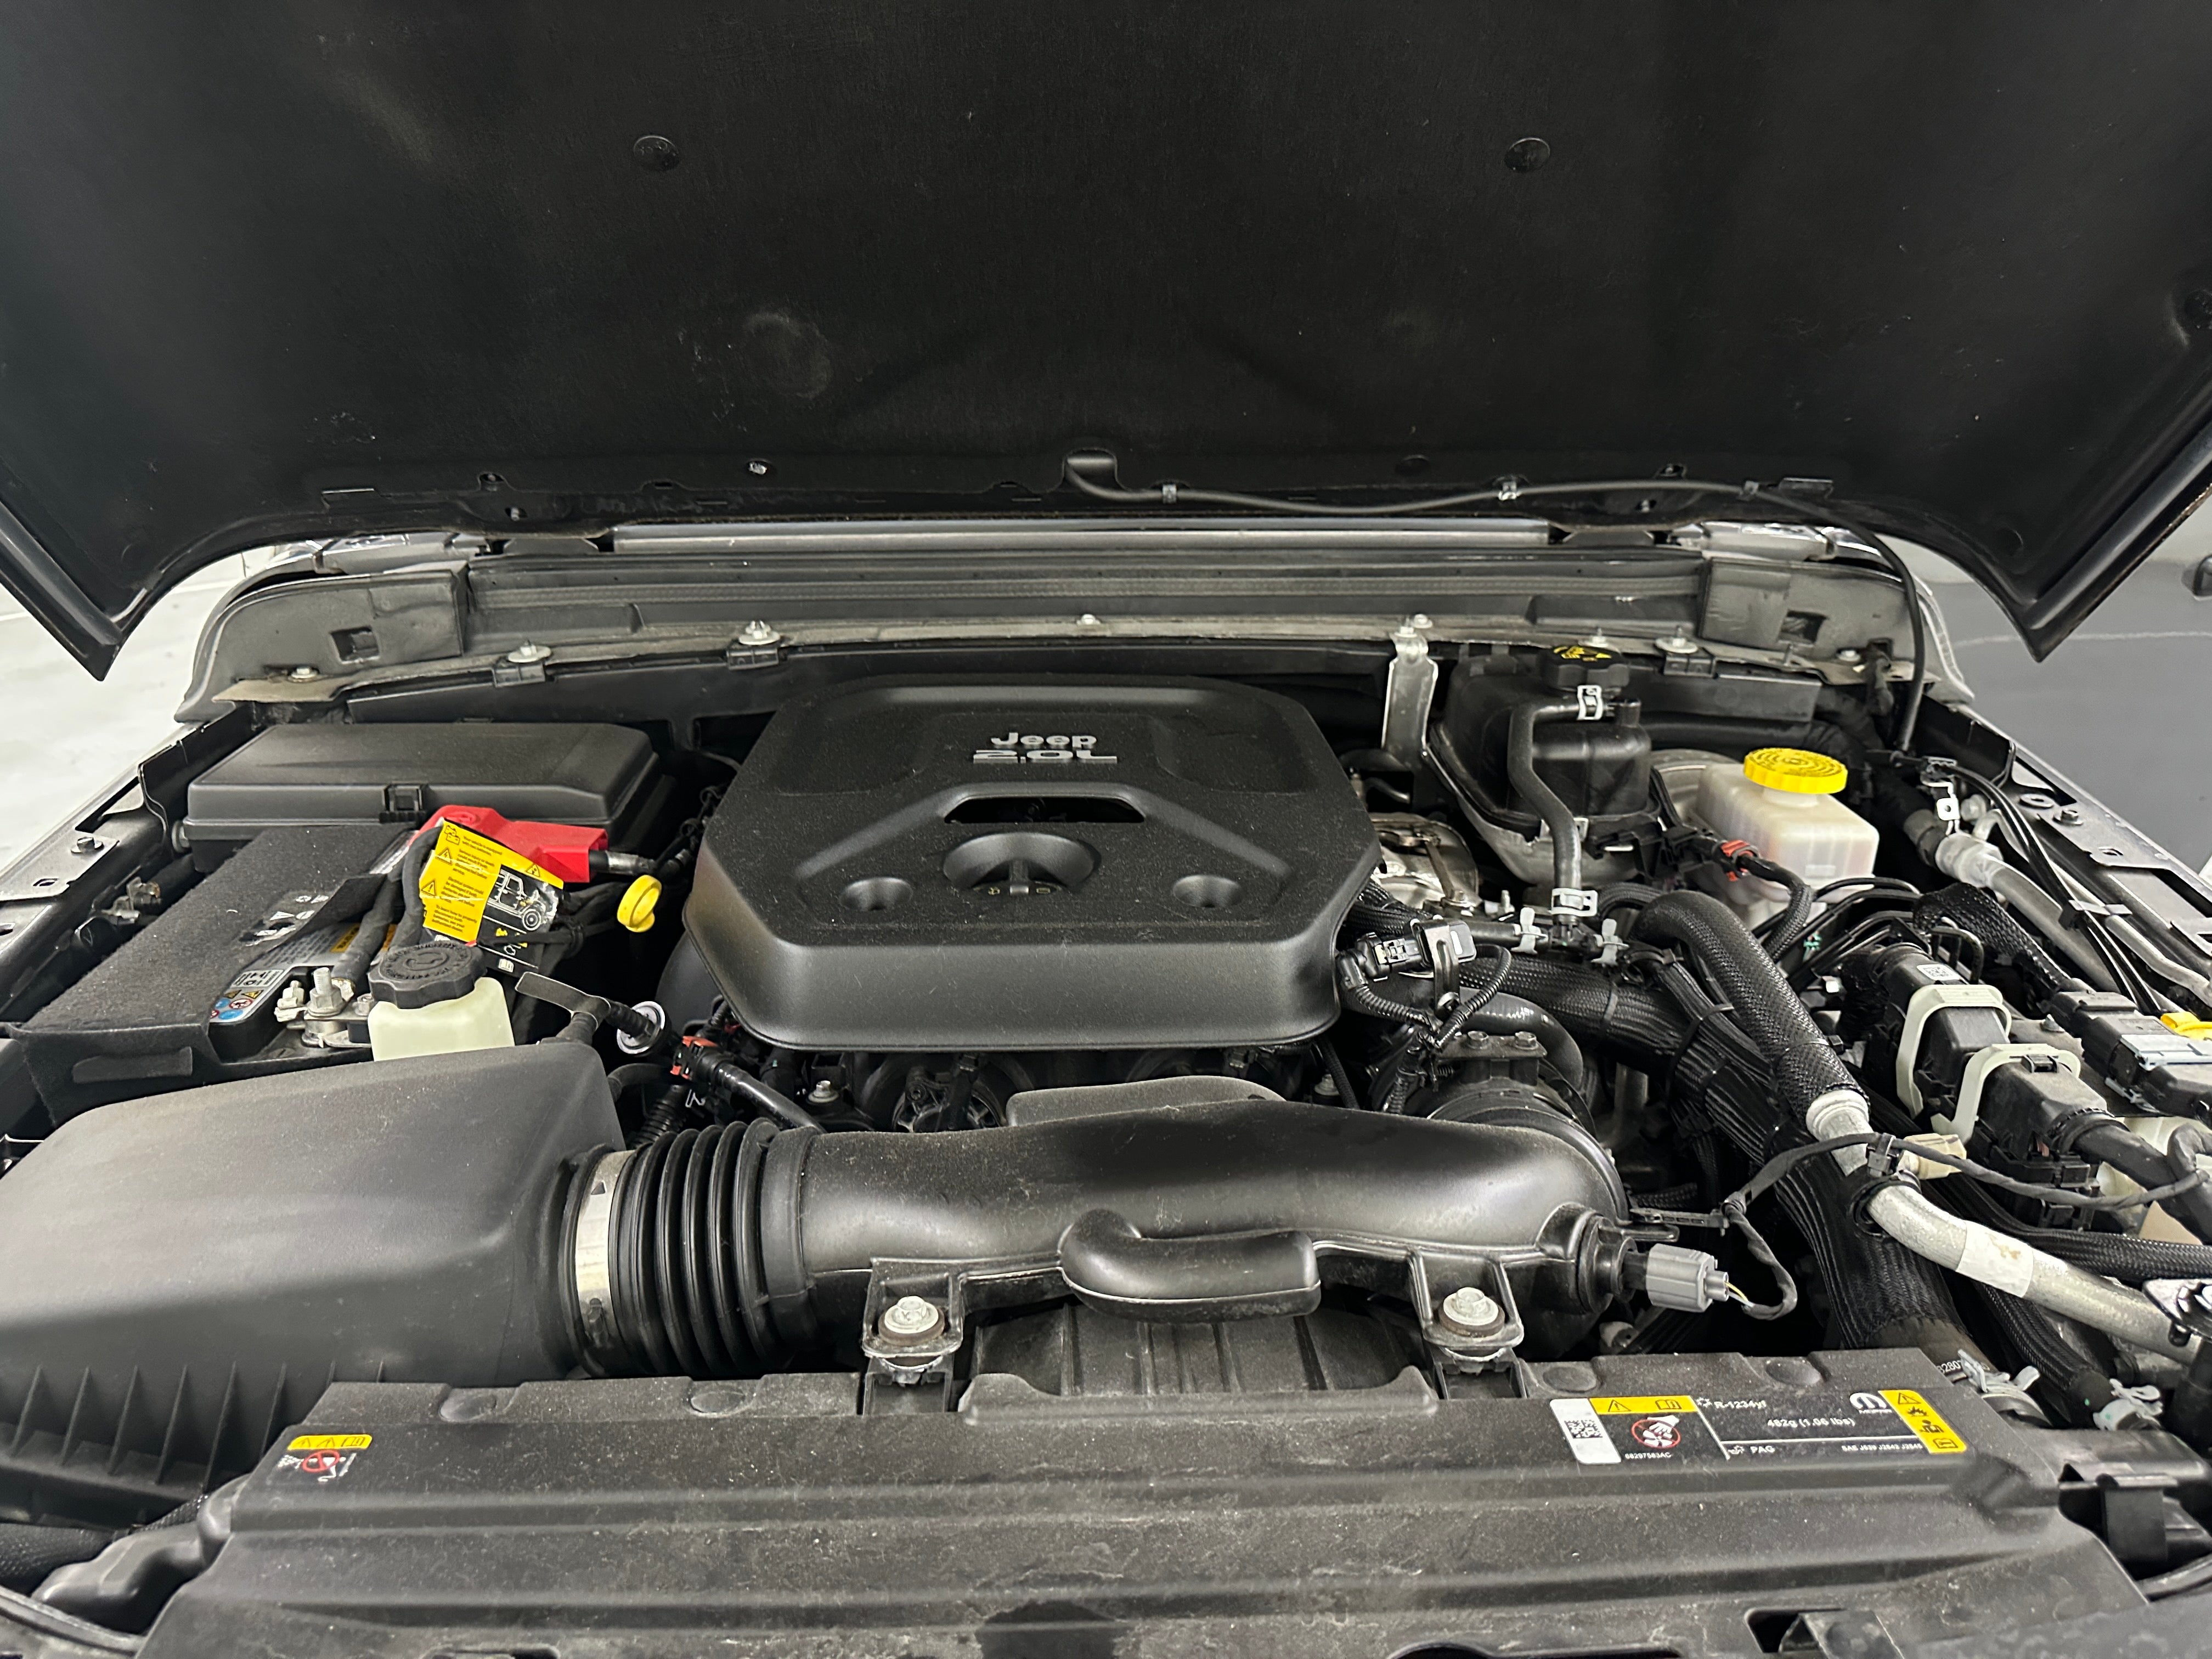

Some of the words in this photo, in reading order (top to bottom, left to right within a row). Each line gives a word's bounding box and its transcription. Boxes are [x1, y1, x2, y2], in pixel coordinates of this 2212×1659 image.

[991, 732, 1097, 749] Jeep
[973, 749, 1118, 764] 2.0L
[1767, 1419, 1798, 1429] 482g
[1798, 1418, 1829, 1427] (1.06
[1830, 1418, 1855, 1426] lbs)
[1750, 1445, 1775, 1453] PAG
